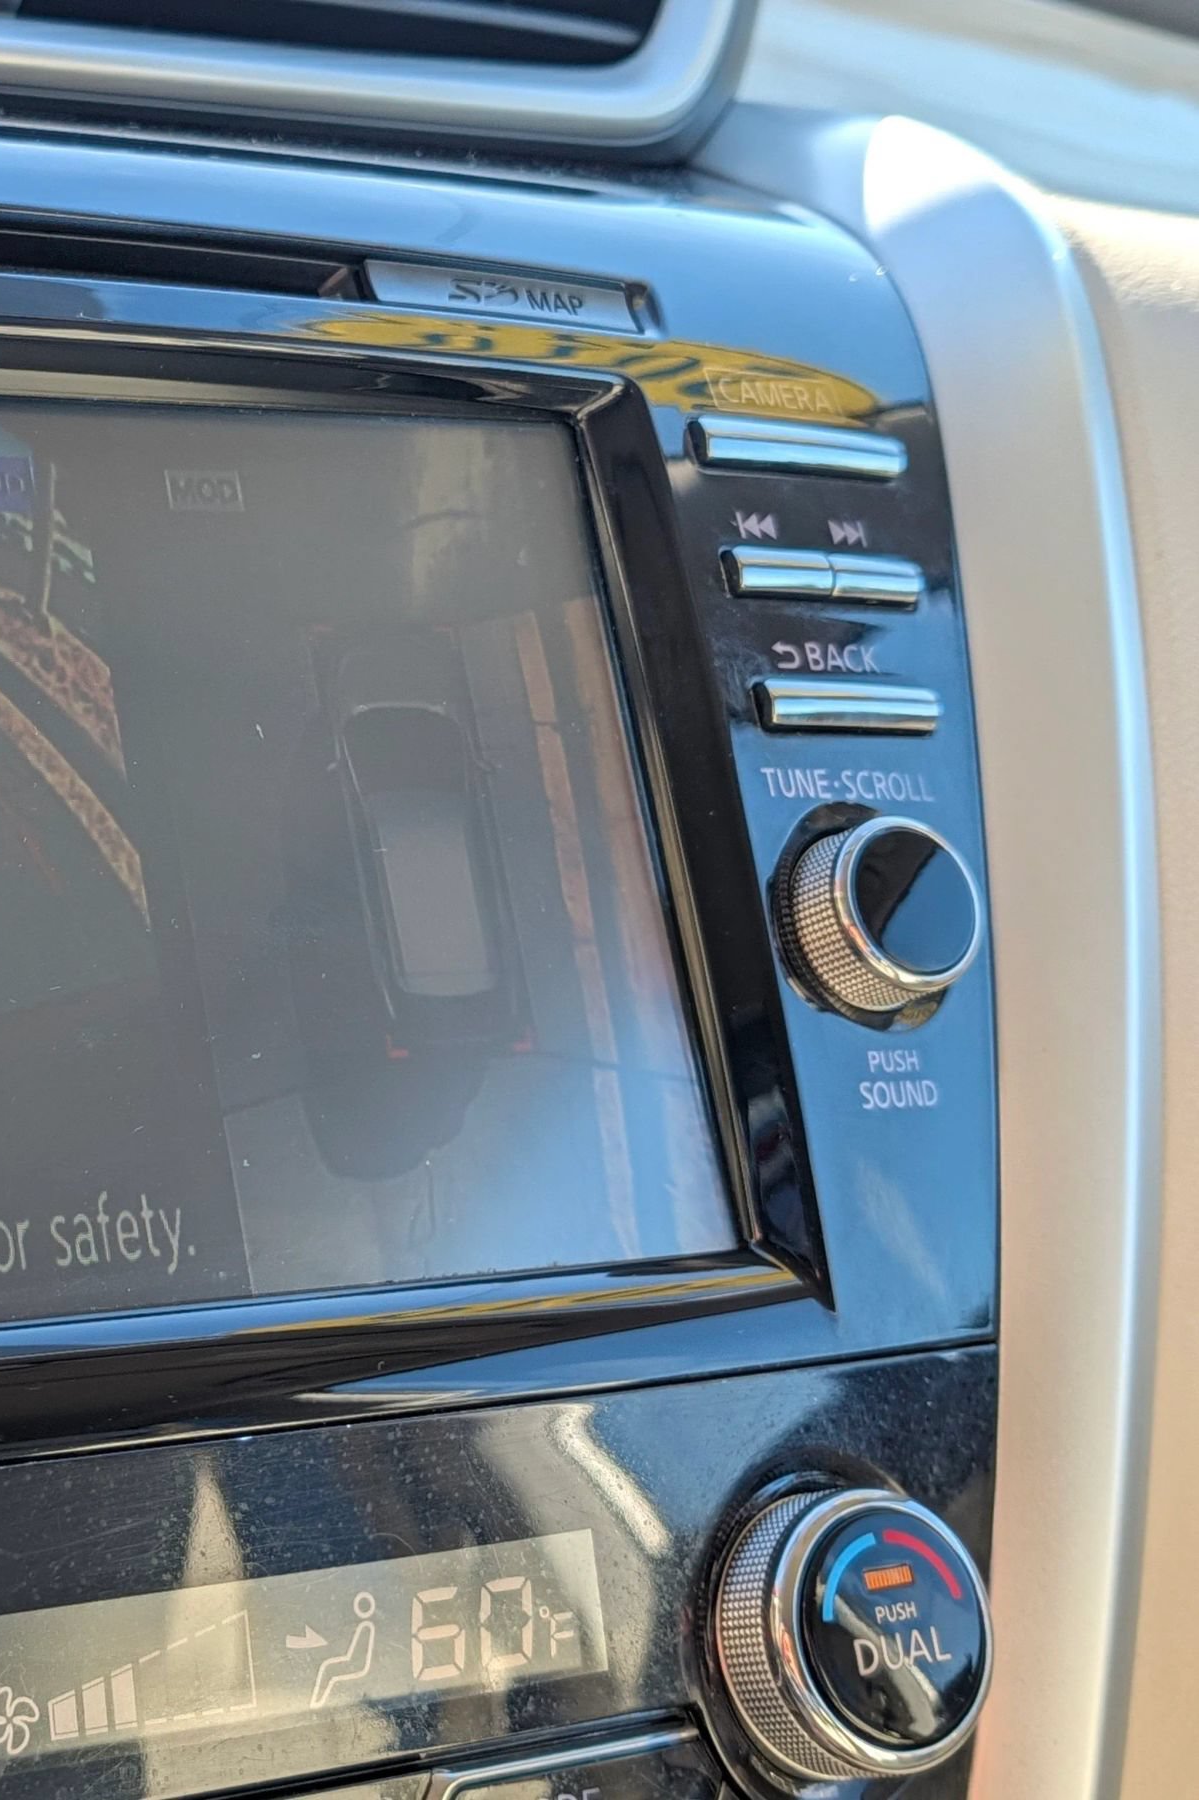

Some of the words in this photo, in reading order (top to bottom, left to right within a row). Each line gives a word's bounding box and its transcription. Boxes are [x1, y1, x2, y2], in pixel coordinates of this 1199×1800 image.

[524, 287, 583, 316] MAP
[718, 376, 834, 413] CAMERA
[805, 641, 880, 673] BACK
[867, 1049, 920, 1073] PUSH
[859, 1080, 938, 1110] SOUND
[50, 1190, 196, 1275] safety.
[875, 1601, 917, 1623] PUSH
[853, 1625, 953, 1677] DUAL
